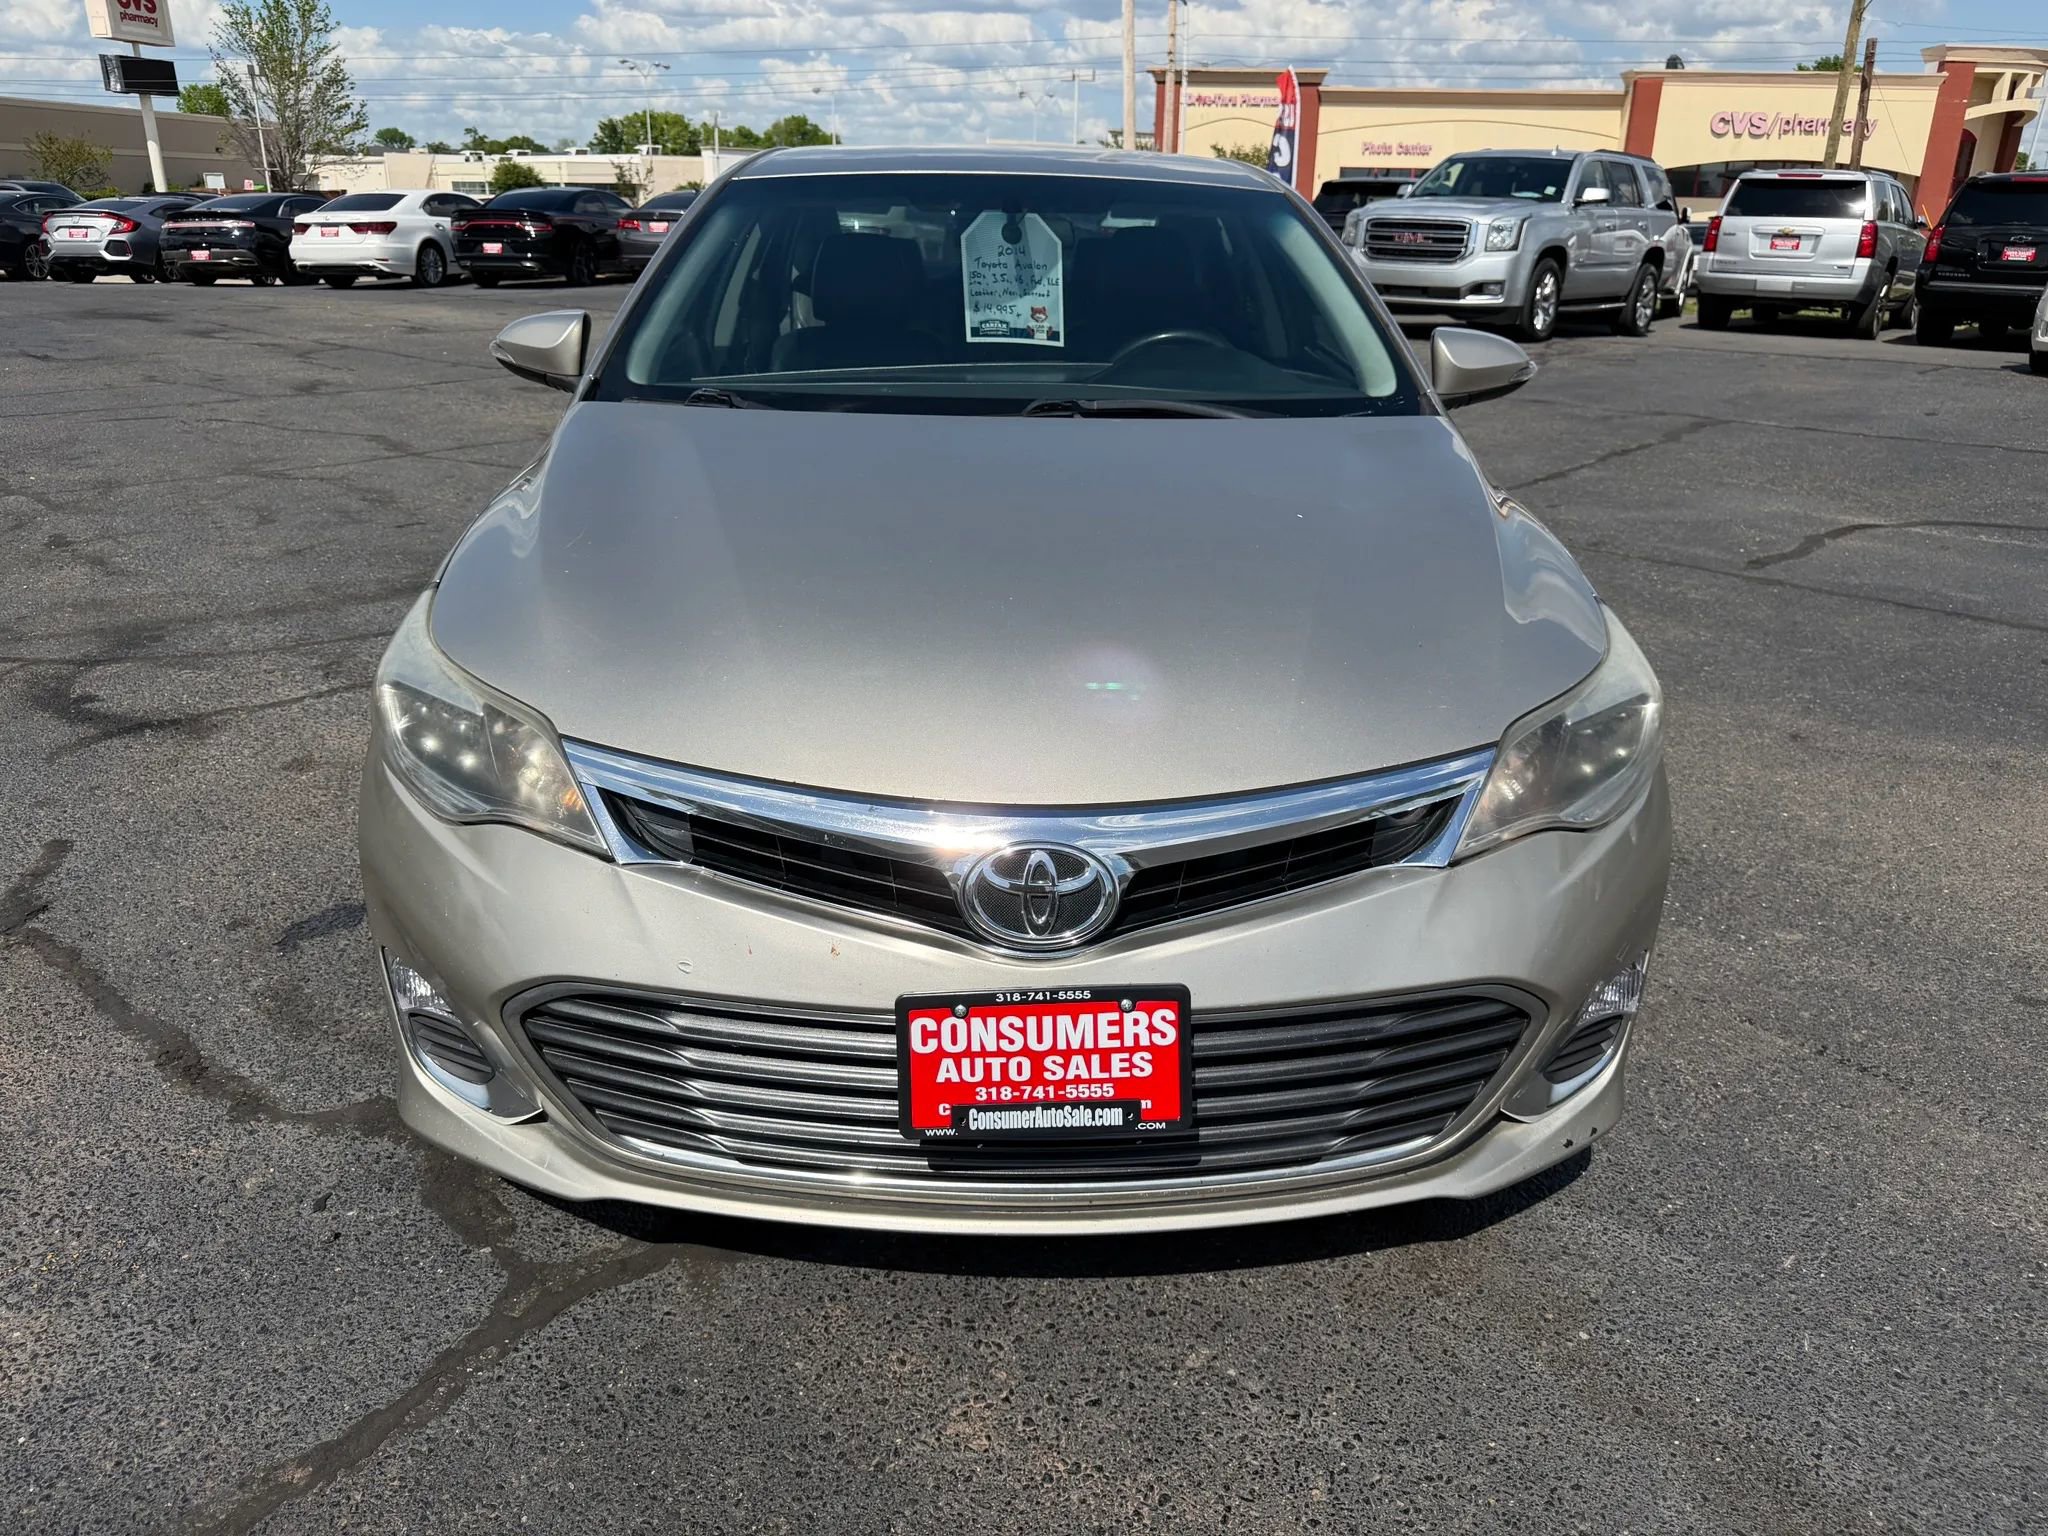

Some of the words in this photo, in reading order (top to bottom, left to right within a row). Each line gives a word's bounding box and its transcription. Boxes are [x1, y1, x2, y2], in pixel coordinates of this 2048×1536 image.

[119, 10, 159, 28] pharmacy
[1240, 93, 1280, 107] Pharma
[1711, 111, 1878, 140] CVS/pharay
[1362, 142, 1393, 156] Photo
[1396, 143, 1433, 156] Center
[997, 245, 1026, 257] 2014
[974, 257, 1008, 272] Toyota
[1015, 259, 1048, 271] Avalon
[995, 990, 1092, 1002] 318-741-5555
[910, 1008, 1177, 1054] CONSUMERS
[936, 1056, 1032, 1083] AUTO
[1042, 1051, 1154, 1081] SALES
[975, 1083, 1115, 1101] 318-741-5555
[968, 1107, 1124, 1131] ConsumerAutoSale.com
